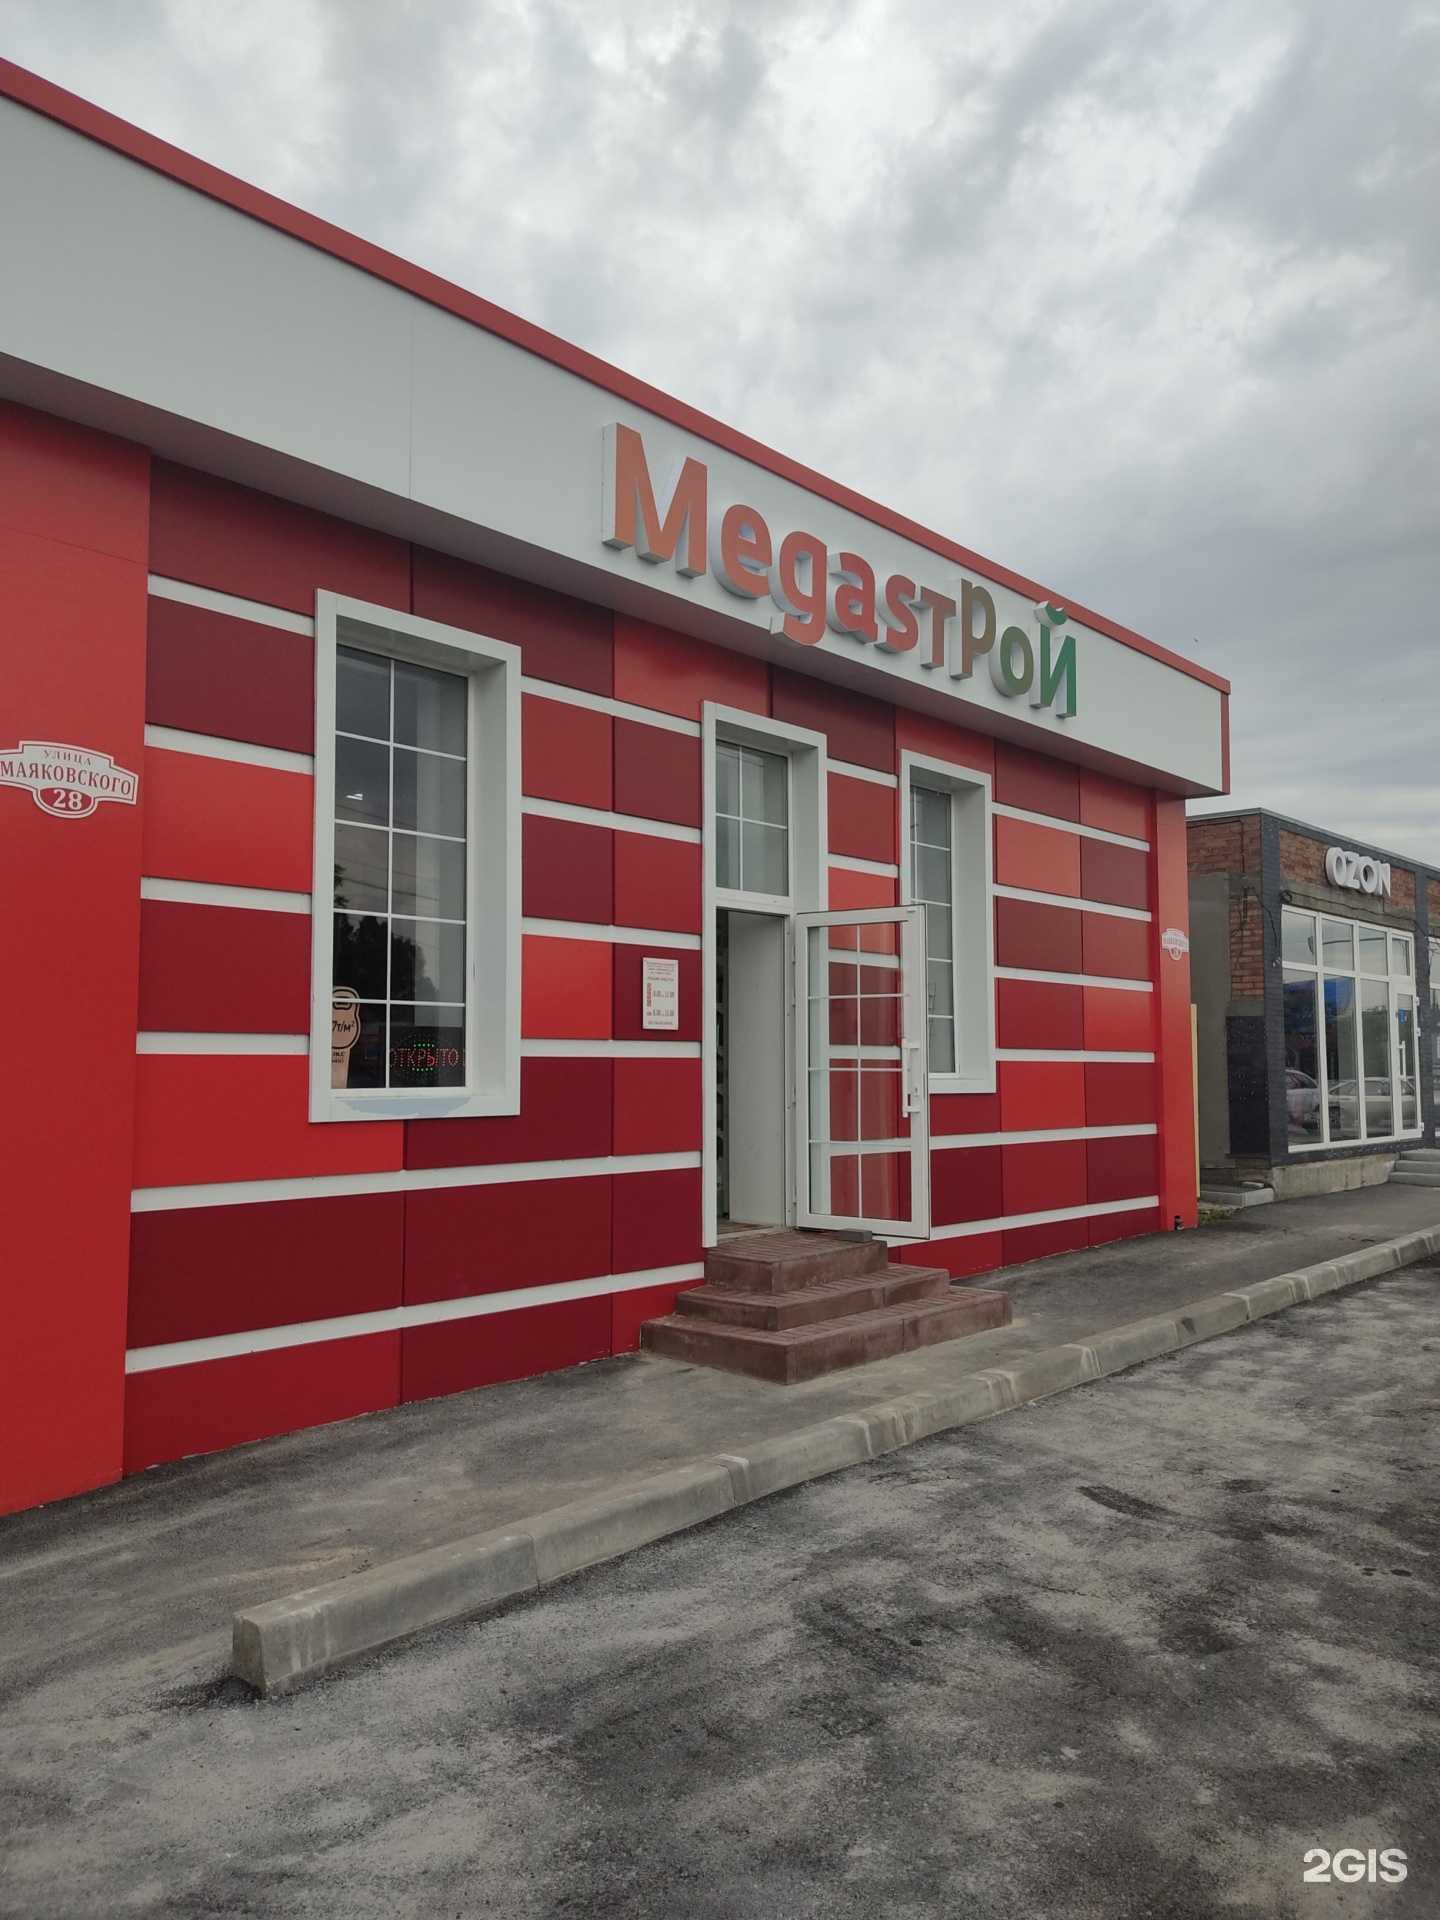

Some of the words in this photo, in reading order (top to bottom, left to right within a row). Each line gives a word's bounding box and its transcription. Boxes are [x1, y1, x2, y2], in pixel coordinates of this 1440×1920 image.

[43, 749, 91, 766] УЛИЦА
[0, 760, 131, 796] МАЯКОВСКОГО
[53, 789, 82, 810] 28
[1326, 847, 1391, 897] OZON
